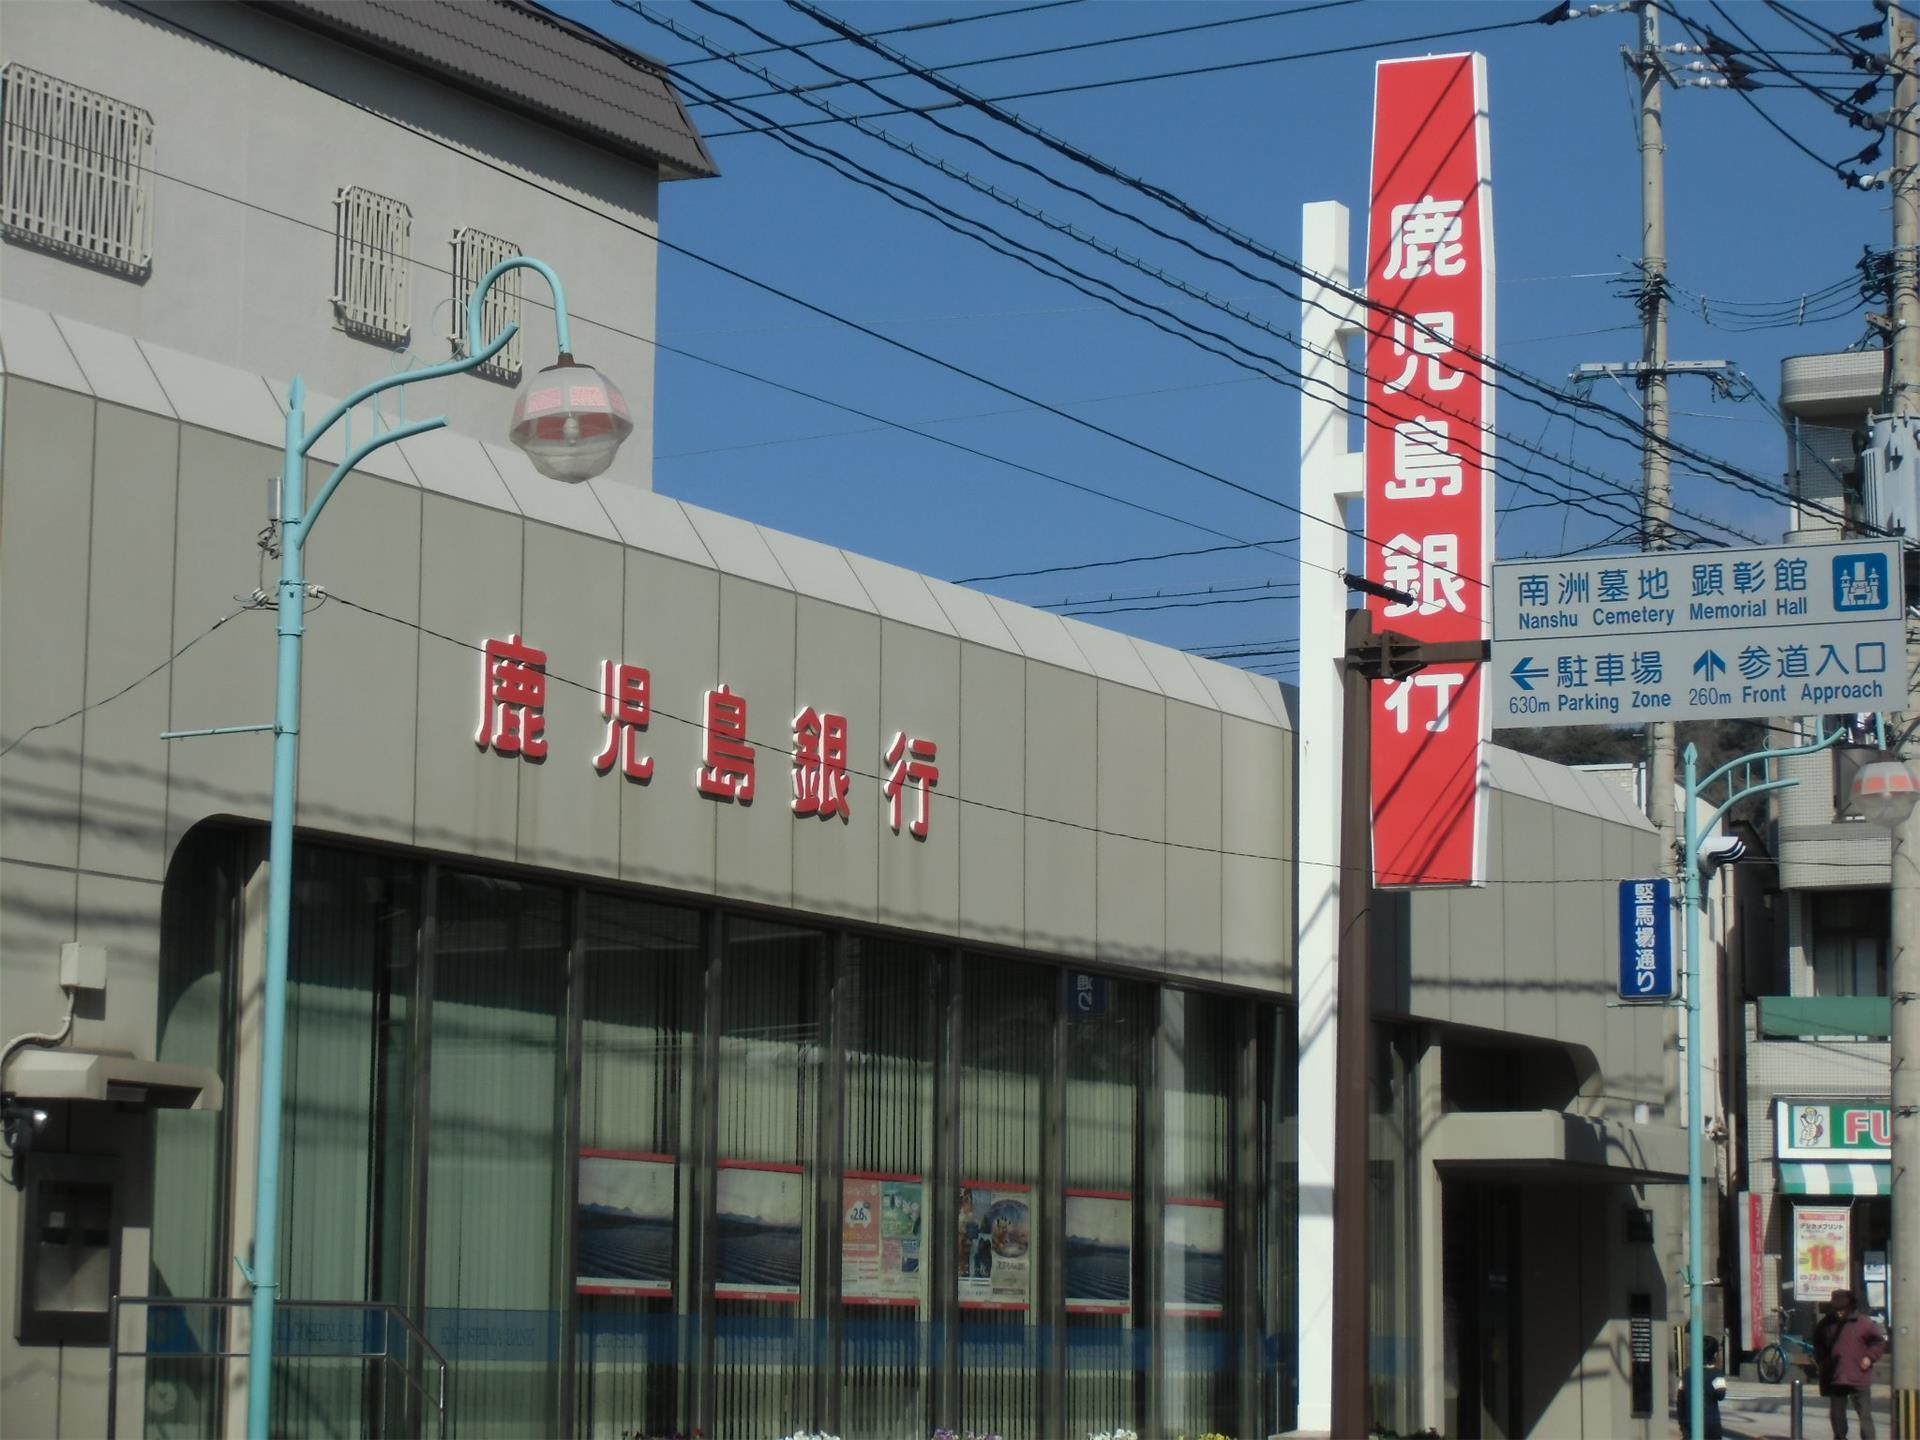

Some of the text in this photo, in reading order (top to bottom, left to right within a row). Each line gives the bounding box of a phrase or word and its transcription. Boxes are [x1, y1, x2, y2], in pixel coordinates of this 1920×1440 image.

[1381, 195, 1467, 734] 鹿児島銀行
[1517, 556, 1809, 607] 南洲墓地 顕彰館
[1518, 596, 1808, 630] Nanshu Cemetery Memorial Hall
[1556, 650, 1664, 689] 駐車場
[1737, 641, 1888, 681] 参道入口
[1509, 690, 1671, 715] 630m Parking Zone
[1688, 679, 1883, 707] 260m Front Approach
[474, 633, 939, 838] 鹿児島銀行
